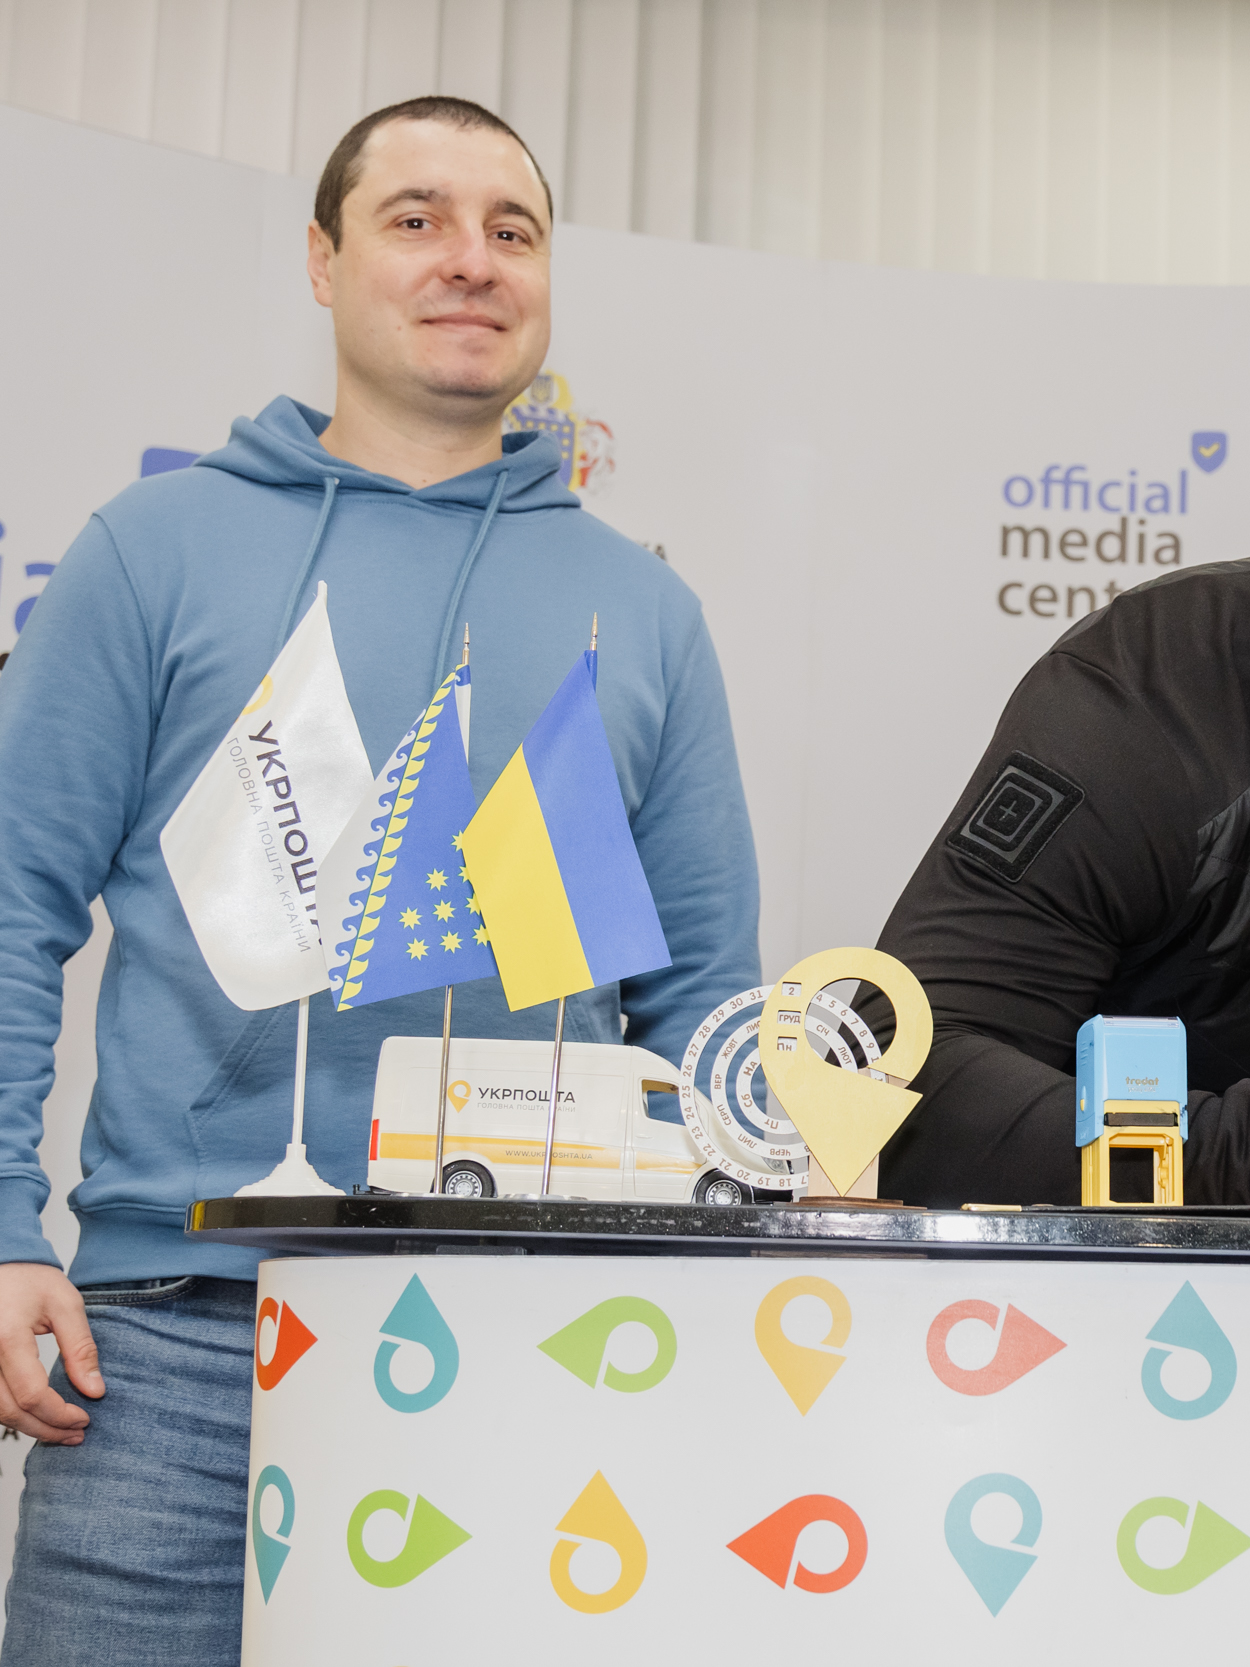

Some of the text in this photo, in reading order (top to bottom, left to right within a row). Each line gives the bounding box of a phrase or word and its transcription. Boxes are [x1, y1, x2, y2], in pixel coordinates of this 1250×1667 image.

[1002, 464, 1188, 514] official
[1000, 516, 1182, 566] media
[248, 719, 322, 945] УКРПОШ
[226, 737, 311, 953] ГОЛОВНА ПОШТА КРАЇНИ
[749, 990, 763, 1001] 31
[788, 987, 795, 996] 2
[730, 997, 744, 1010] 30
[712, 1009, 725, 1023] 29
[779, 1014, 801, 1024] ГРУД
[816, 994, 823, 1002] 4
[828, 1000, 837, 1008] 5
[840, 1009, 848, 1017] 6
[850, 1018, 860, 1026] 7
[859, 1030, 868, 1038] 8
[698, 1025, 711, 1039] 28
[688, 1043, 699, 1057] 27
[721, 1038, 738, 1059] ЖОВТ
[816, 1024, 852, 1065] СІЧ ЛЮТ
[683, 1064, 693, 1077] 26
[714, 1074, 722, 1090] ВЕР
[1125, 1076, 1159, 1086] trodat
[682, 1085, 691, 1099] 25
[477, 1102, 515, 1110] ГОЛОВНА
[684, 1106, 695, 1120] 24
[716, 1104, 732, 1126] СЕРП
[691, 1126, 703, 1139] 23
[737, 1133, 757, 1149] ЛИП
[702, 1143, 716, 1157] 22
[770, 1148, 791, 1156] ЧЕРВ
[719, 1158, 732, 1171] 21
[736, 1169, 751, 1181] 20
[757, 1177, 771, 1186] 19
[779, 1178, 791, 1187] 18
